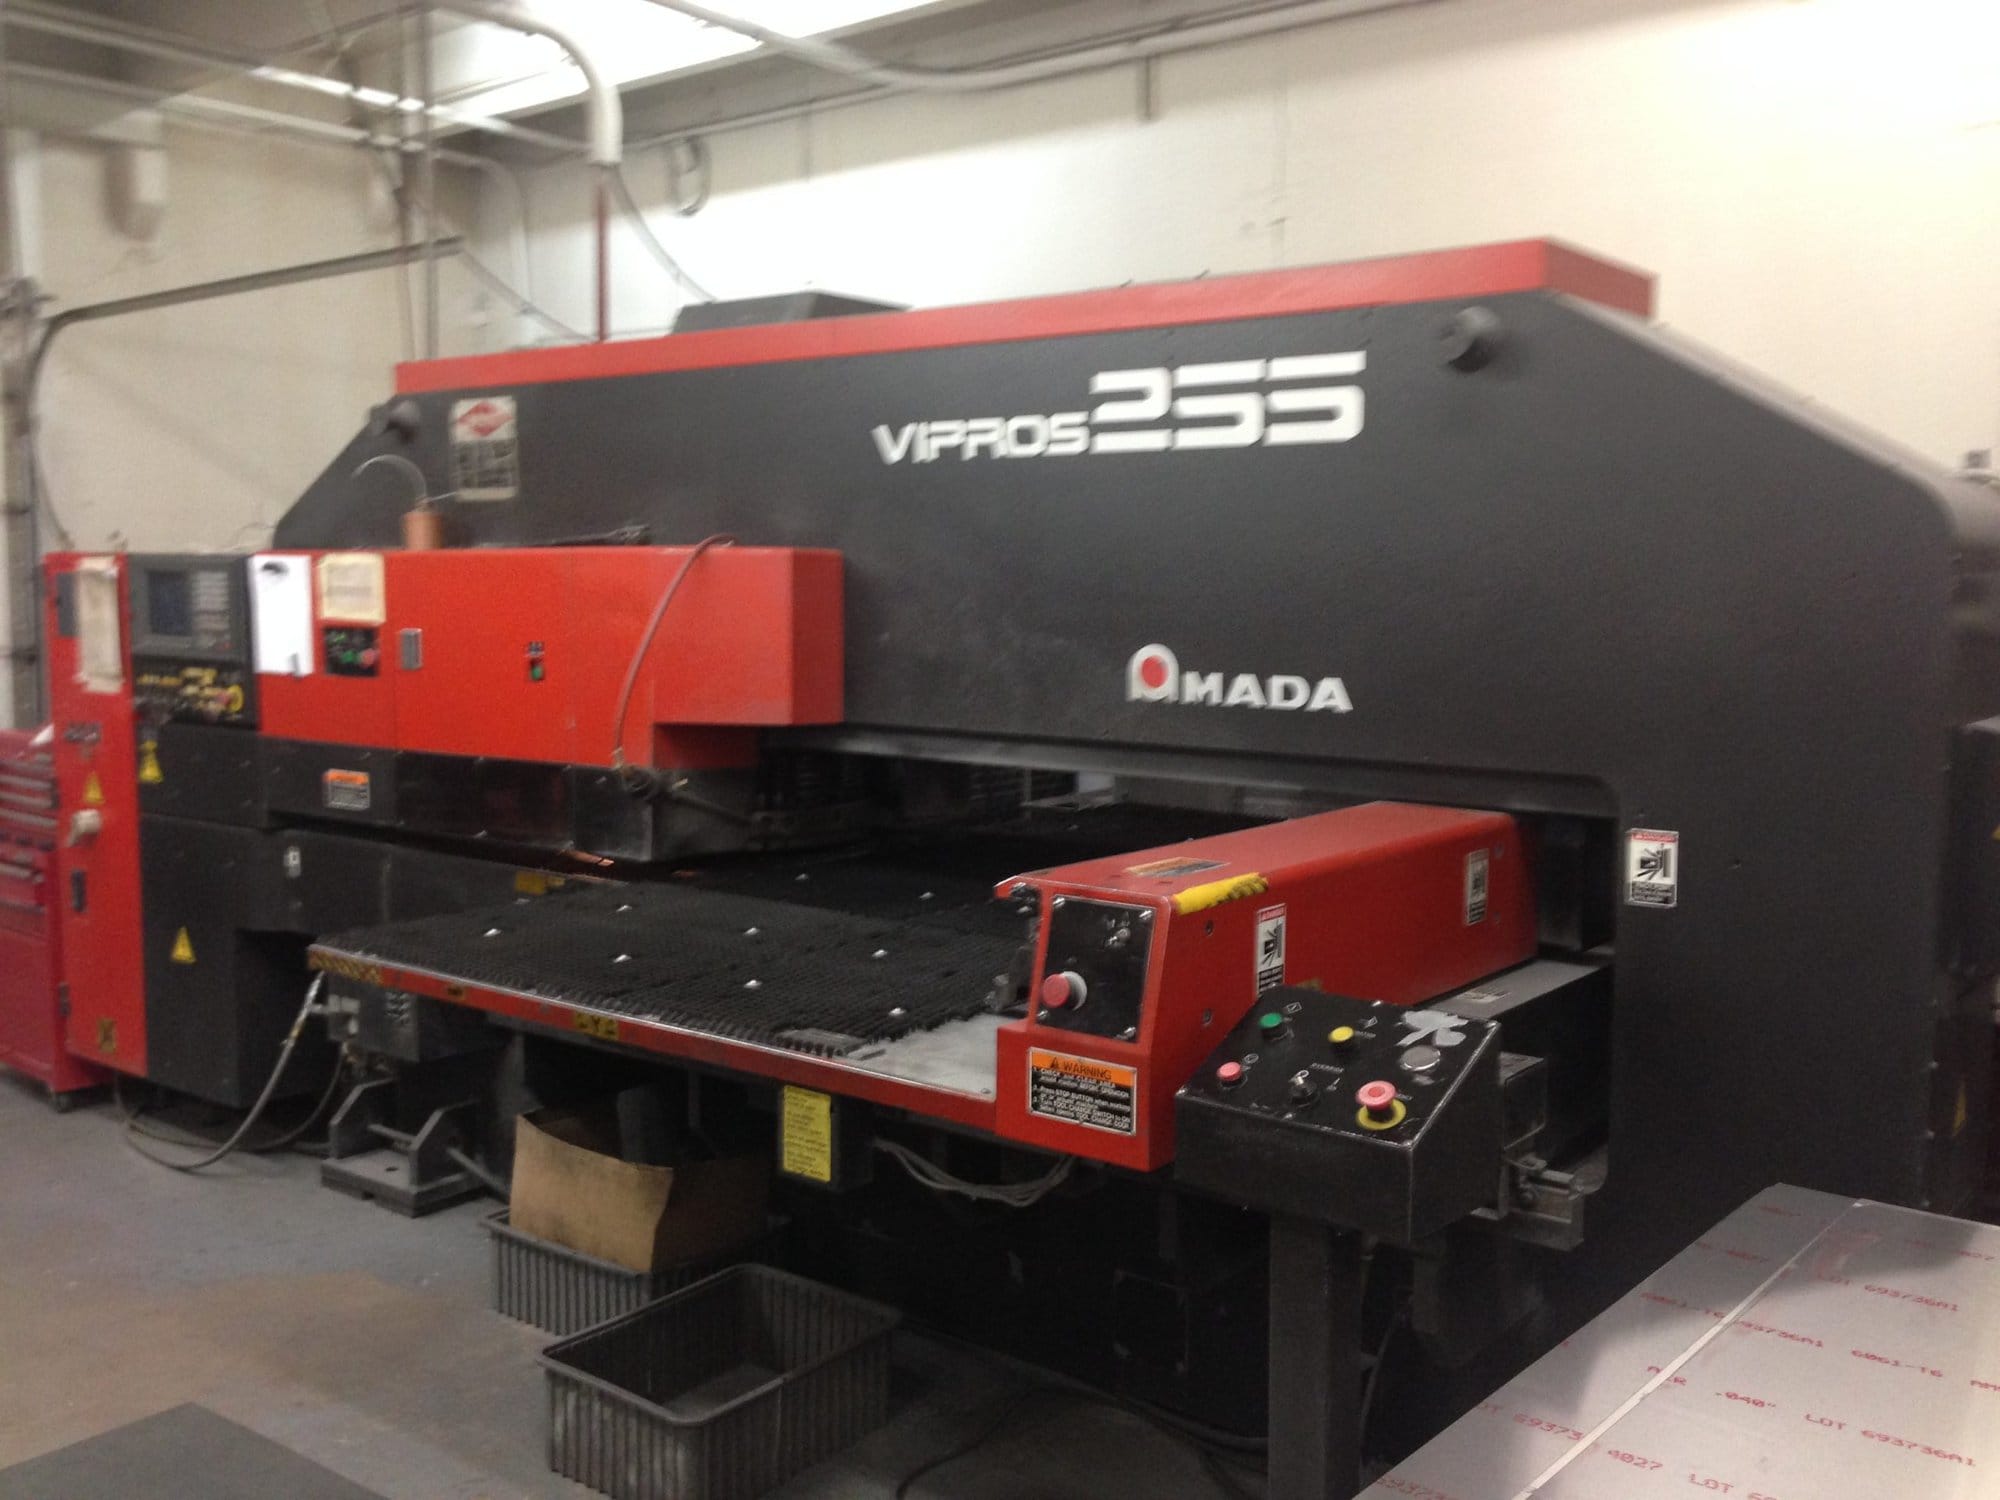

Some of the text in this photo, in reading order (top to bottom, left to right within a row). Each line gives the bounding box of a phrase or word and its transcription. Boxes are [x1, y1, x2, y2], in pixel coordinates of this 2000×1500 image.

[871, 351, 1367, 465] VIPROS 255
[1062, 1061, 1112, 1080] WARNING
[1512, 1412, 1585, 1442] 69373
[1804, 1413, 1847, 1431] LOT
[1860, 1429, 1976, 1467] 693736A1
[1688, 1472, 1735, 1494] LOT
